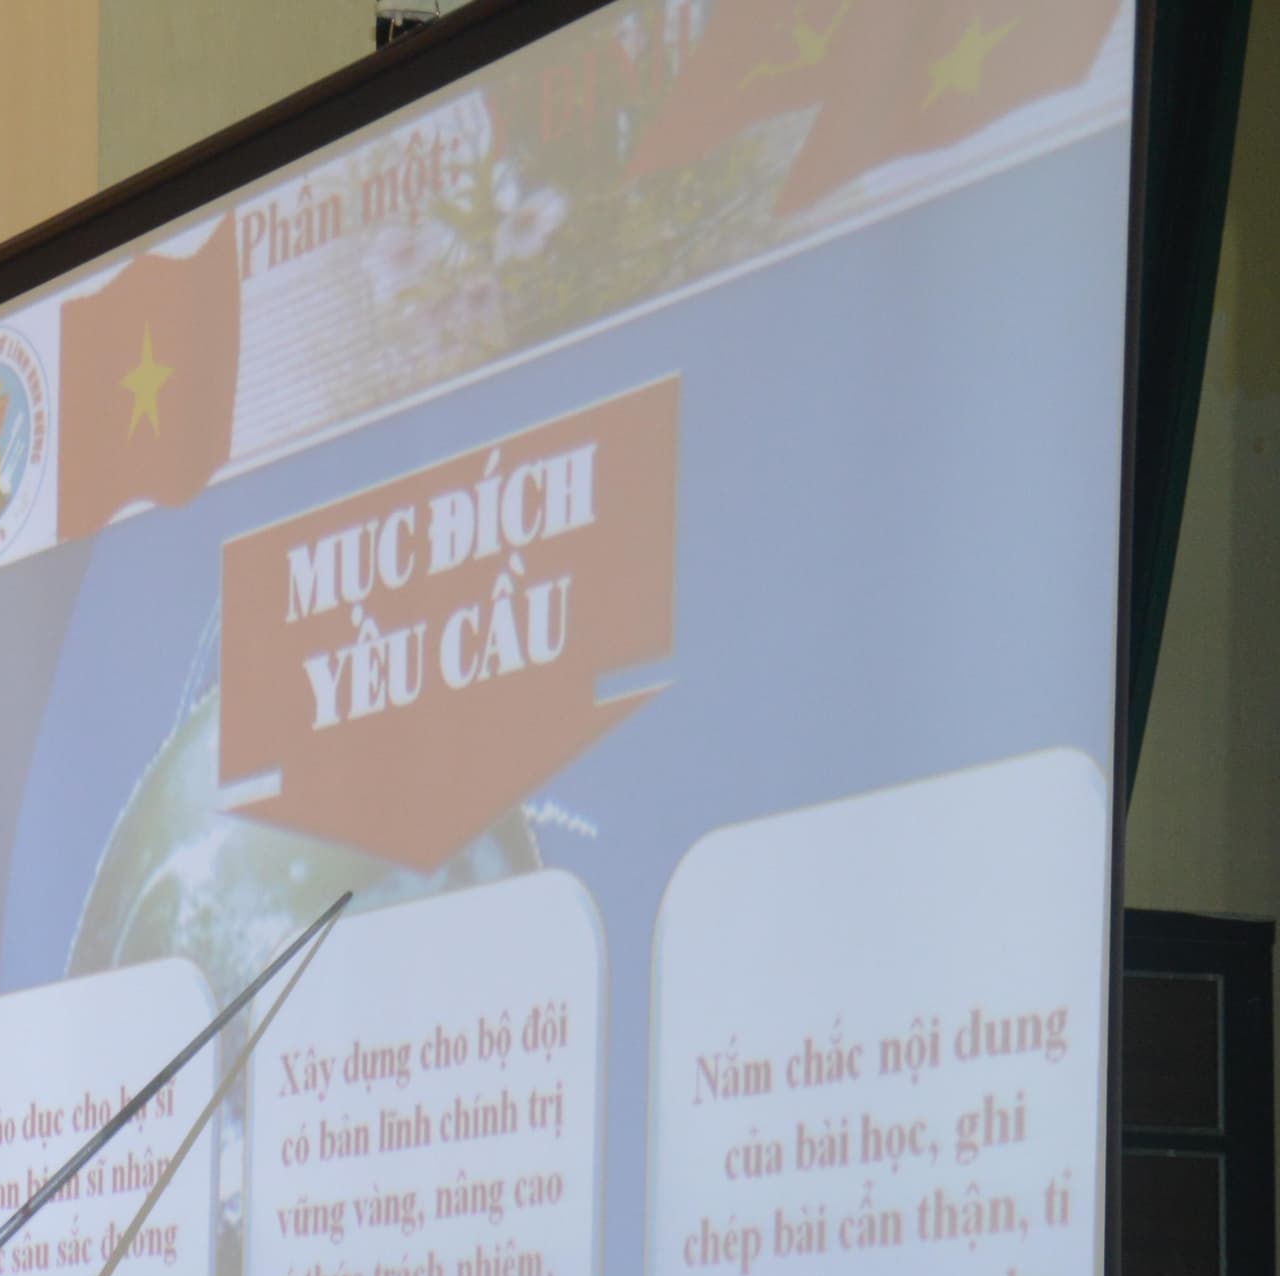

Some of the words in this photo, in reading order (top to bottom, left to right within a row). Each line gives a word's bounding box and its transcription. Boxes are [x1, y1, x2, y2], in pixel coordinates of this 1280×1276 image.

[285, 506, 416, 627] MỤC
[427, 442, 598, 576] ĐÍCH
[302, 613, 427, 730] YÊU
[439, 553, 572, 689] CẦU
[278, 1047, 336, 1101] Xây
[342, 1040, 412, 1093] dựng
[419, 1023, 469, 1073] cho
[477, 1008, 512, 1072] bộ
[521, 1000, 569, 1063] đội
[691, 1032, 773, 1106] Nắm
[785, 1014, 864, 1090] chắc
[877, 1014, 941, 1086] nội
[953, 1005, 1070, 1065] dung
[22, 1102, 64, 1149] dục
[72, 1090, 111, 1133] cho
[281, 1122, 310, 1168] có
[319, 1113, 370, 1162] bản
[378, 1103, 432, 1154] lĩnh
[439, 1089, 518, 1143] chính
[527, 1079, 564, 1139] trị
[724, 1126, 783, 1181] của
[795, 1115, 850, 1173] bài
[954, 1088, 1028, 1167] ghi
[11, 1231, 49, 1272] sâu
[276, 1194, 346, 1244] vững
[352, 1182, 425, 1237] vàng,
[434, 1169, 505, 1225] nâng
[513, 1171, 564, 1209] cao
[683, 1213, 762, 1276] chép
[773, 1201, 828, 1258] bài
[838, 1177, 904, 1250] cẩn
